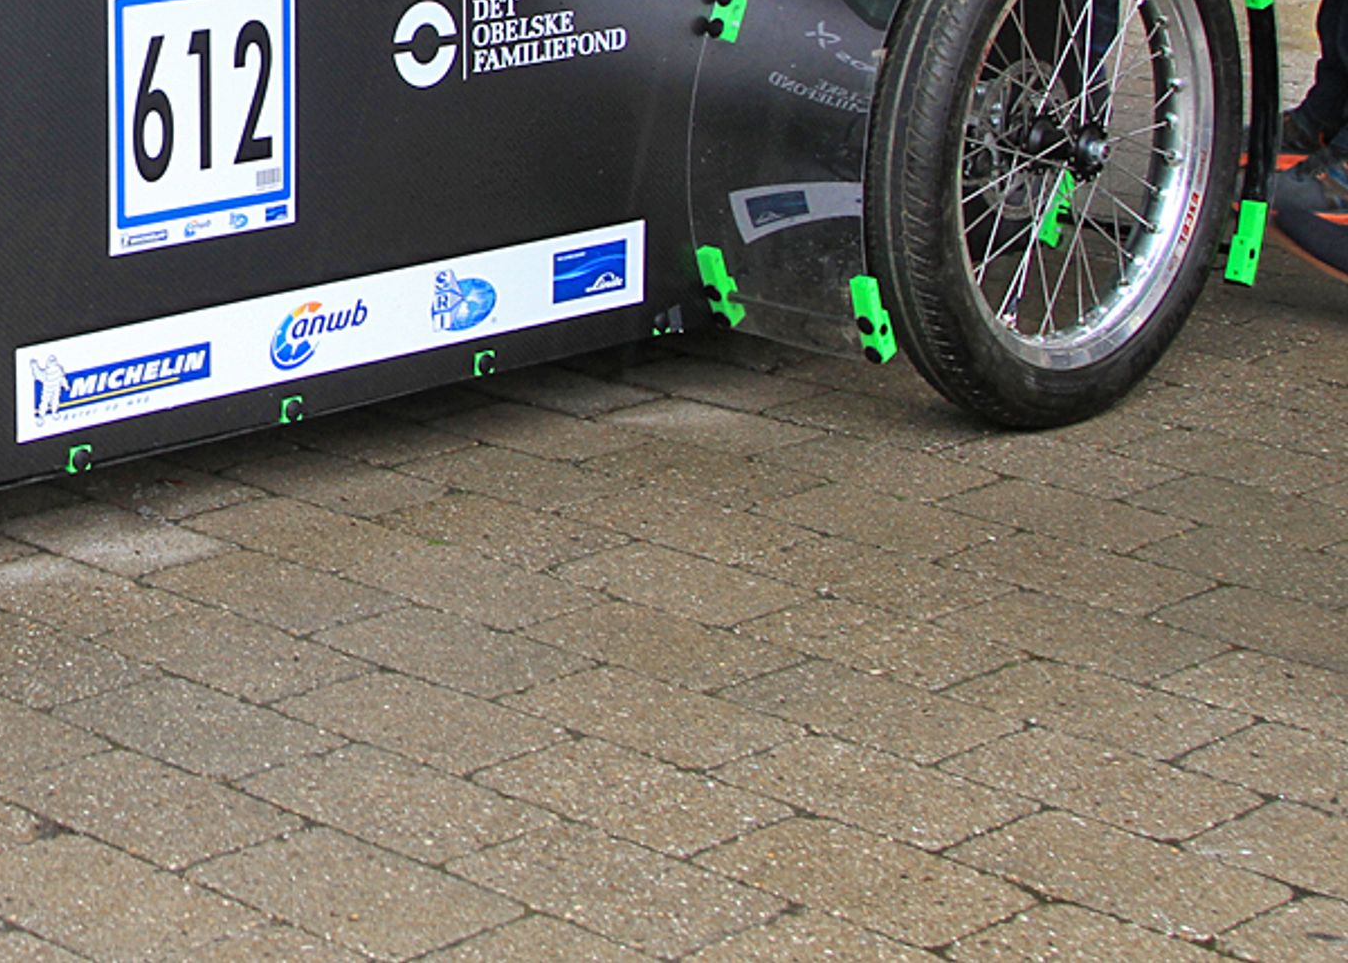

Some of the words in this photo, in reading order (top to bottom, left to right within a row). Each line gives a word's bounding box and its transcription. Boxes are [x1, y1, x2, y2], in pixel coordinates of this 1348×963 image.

[472, 10, 574, 48] OBELSKE
[472, 27, 628, 72] FAMILIEFOND
[133, 19, 273, 183] 612
[292, 298, 369, 339] anwb
[69, 349, 206, 399] MICHELIN
